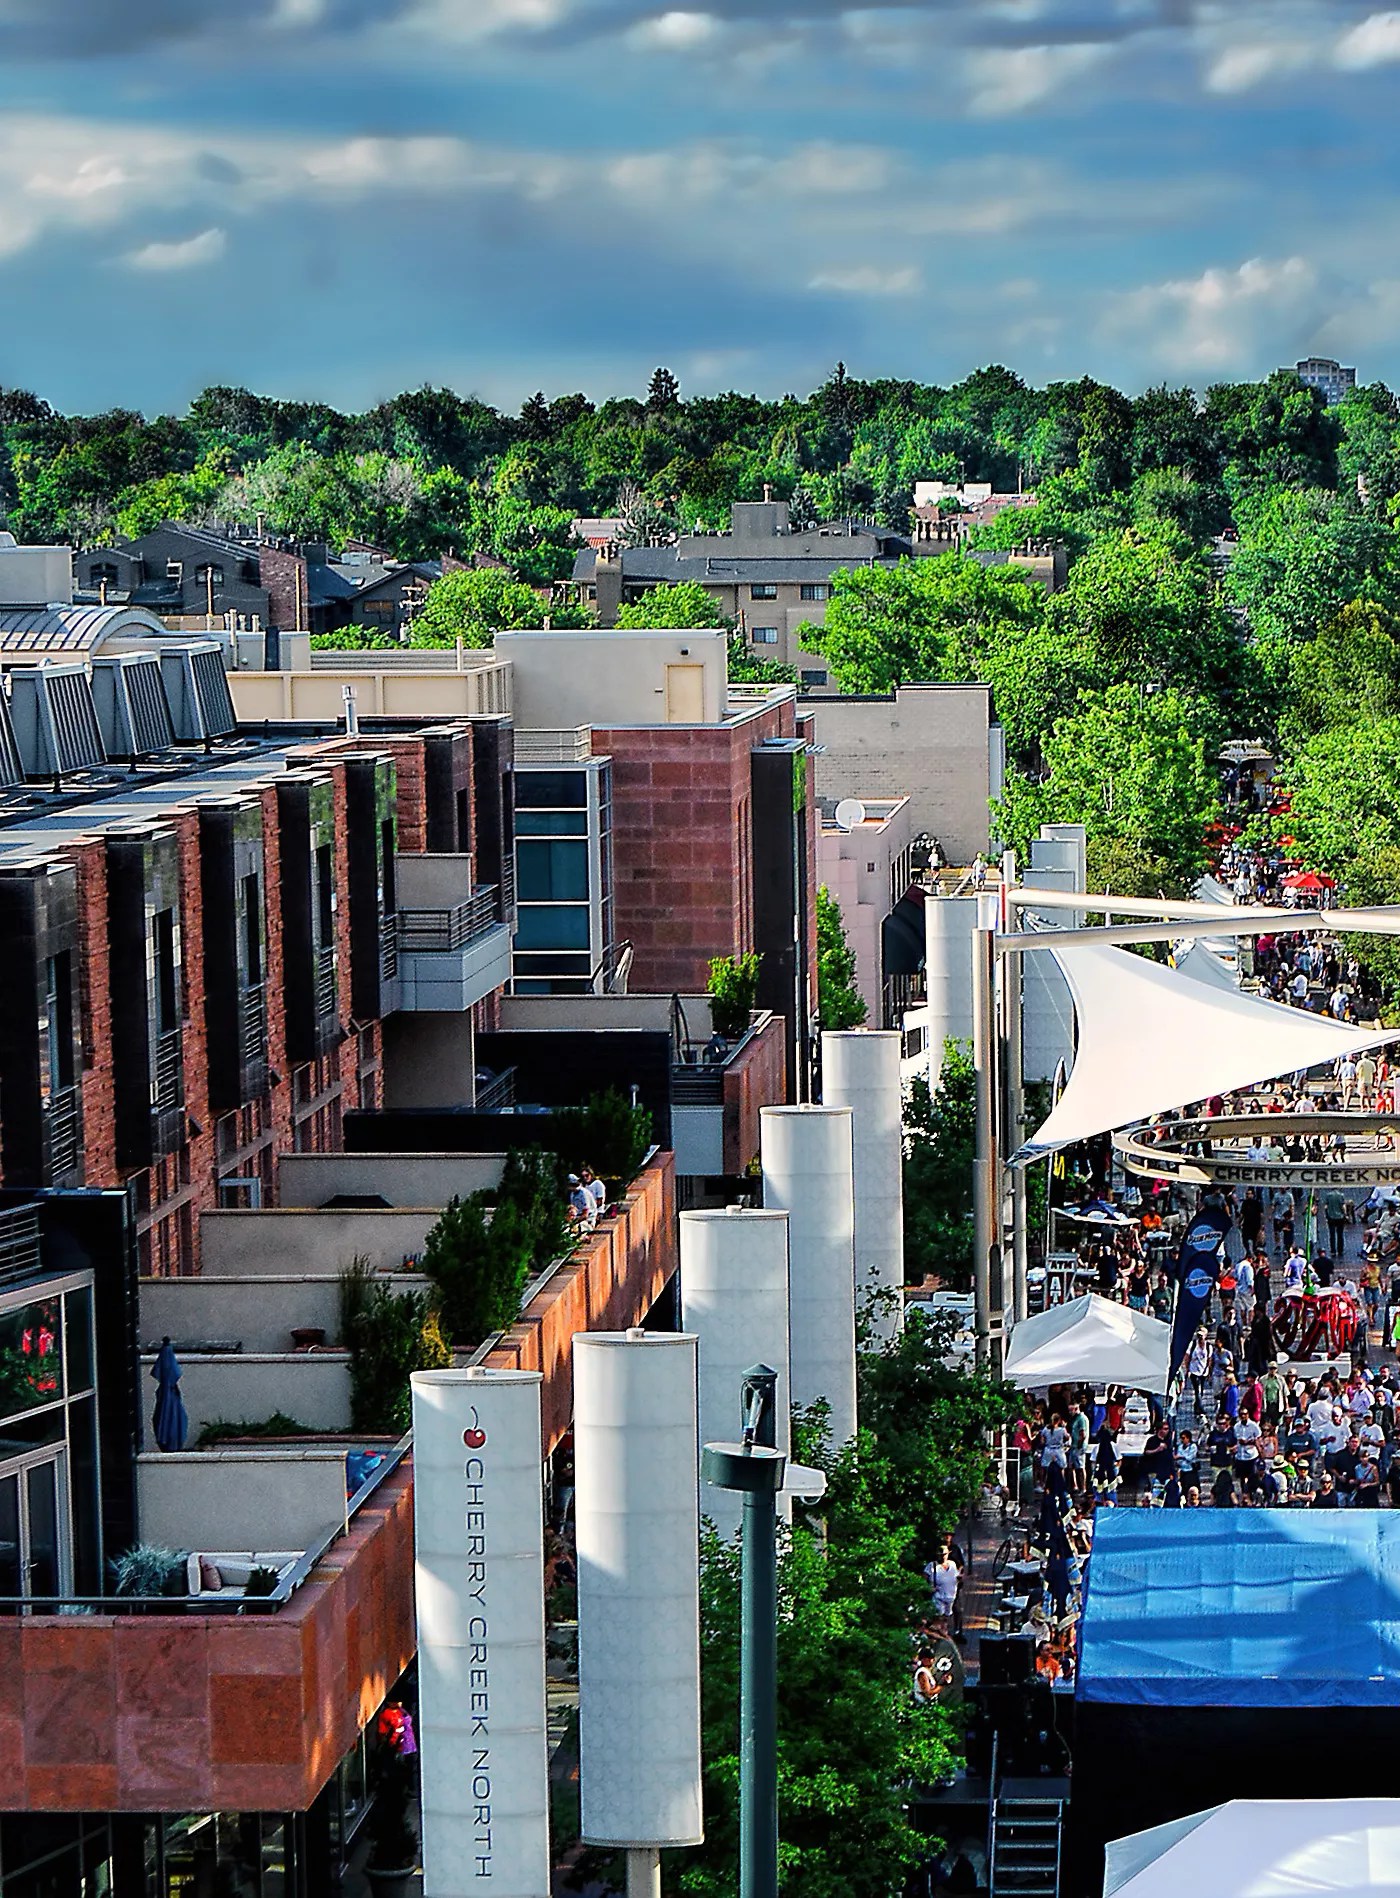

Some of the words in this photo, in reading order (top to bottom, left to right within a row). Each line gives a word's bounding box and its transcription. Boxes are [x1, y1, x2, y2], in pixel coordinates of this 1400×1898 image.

[1215, 1167, 1293, 1182] CHERRY
[1301, 1168, 1369, 1183] CREEK
[1050, 1260, 1074, 1269] ATM
[464, 1459, 486, 1608] CHERRY
[469, 1617, 489, 1736] CREEK
[472, 1751, 492, 1878] NORTH
